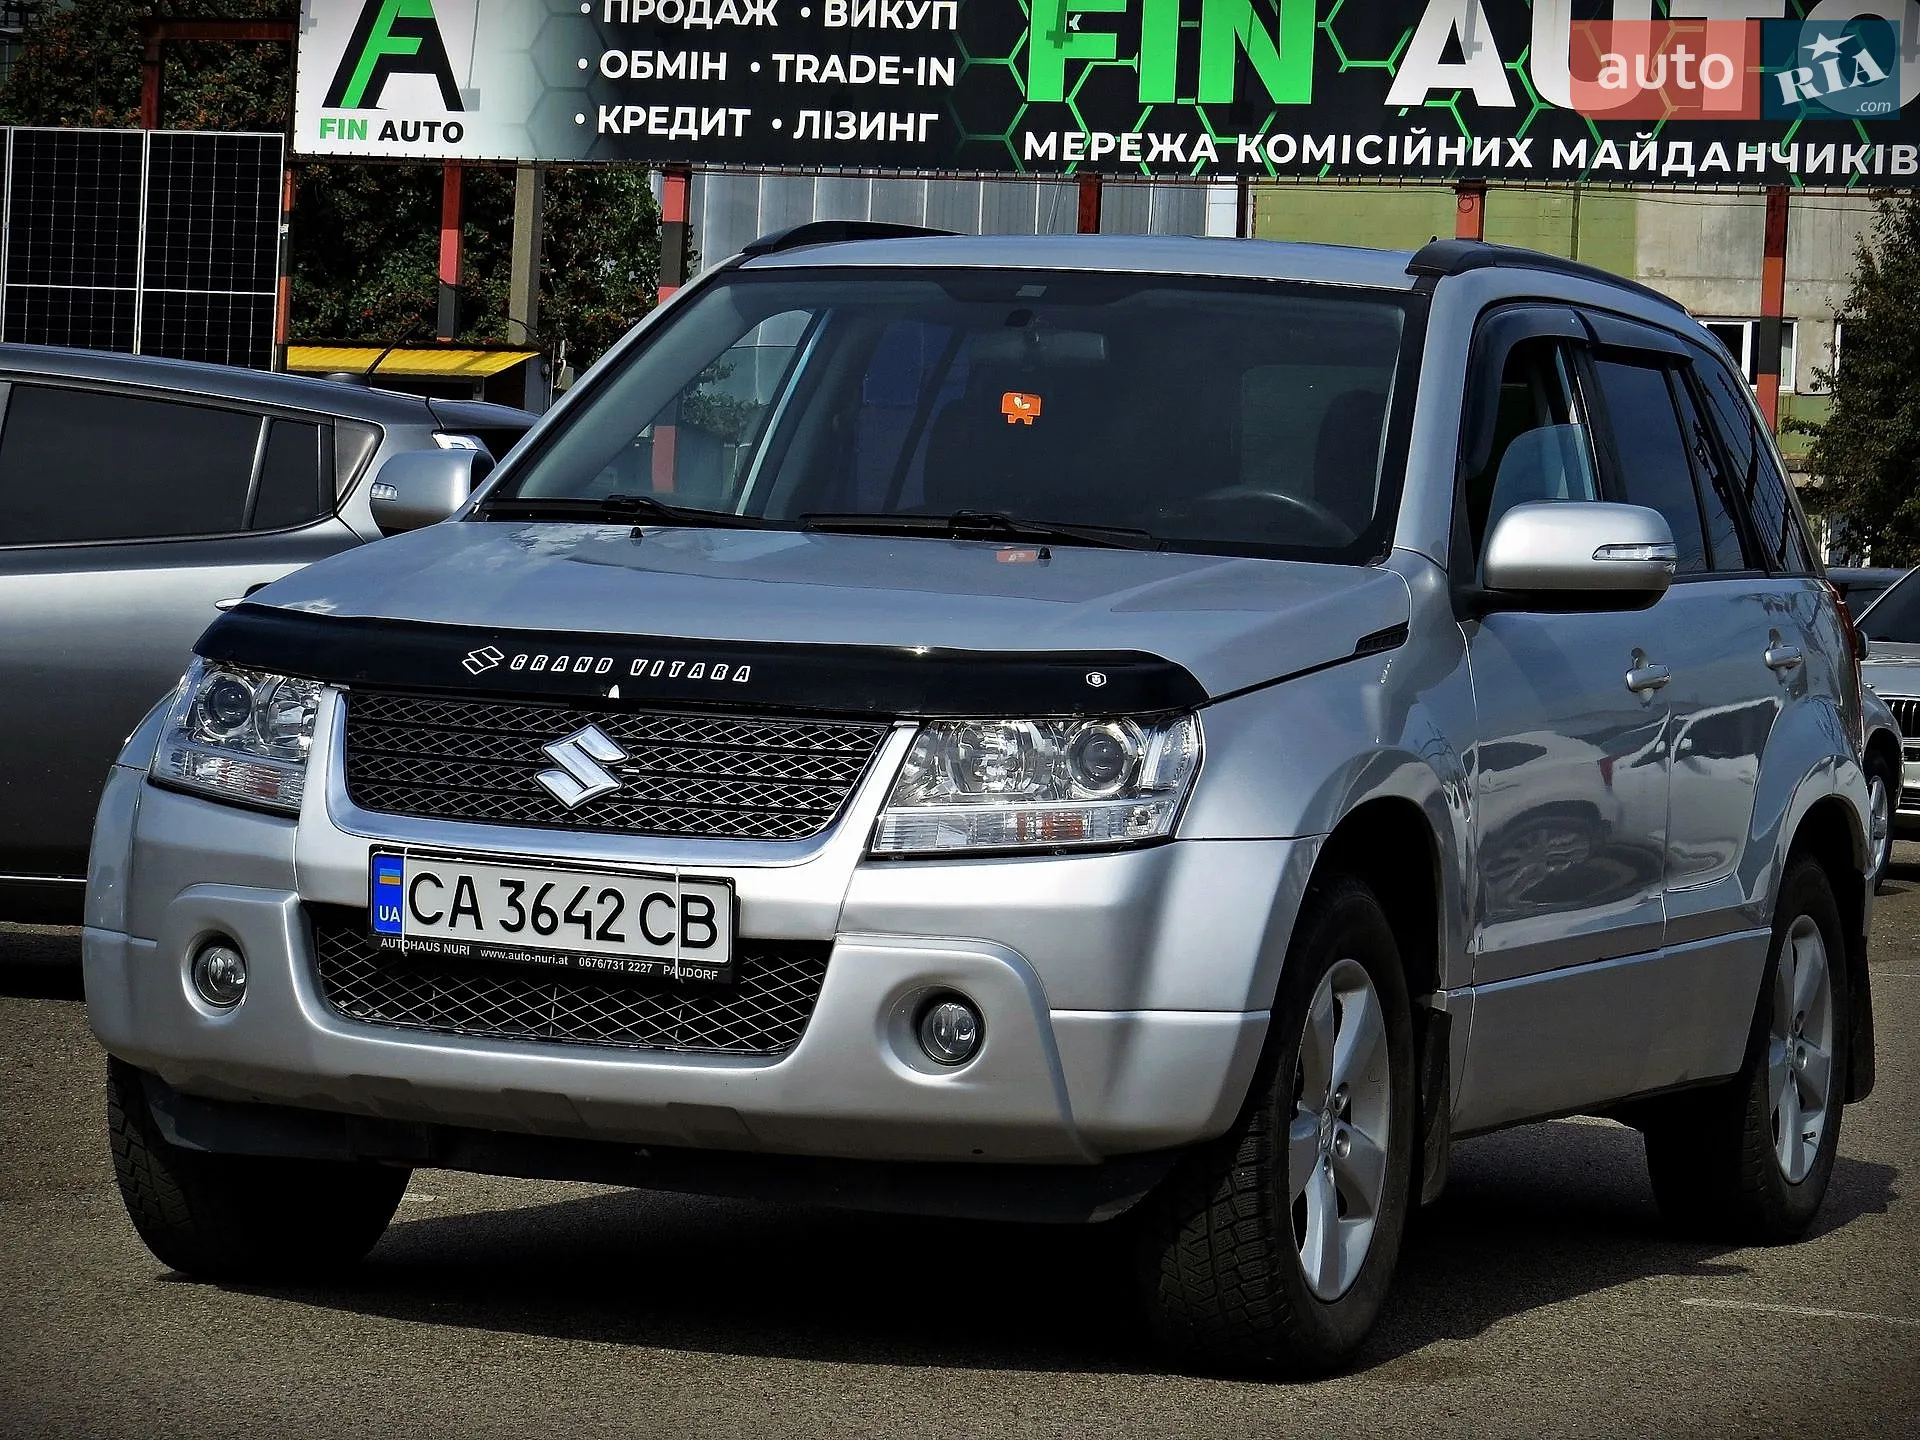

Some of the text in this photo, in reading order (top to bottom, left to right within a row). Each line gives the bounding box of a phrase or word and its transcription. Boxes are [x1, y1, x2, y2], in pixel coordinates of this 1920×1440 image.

[603, 0, 778, 30] ПРОДАЖ
[824, 0, 957, 31] ВИКУП
[600, 50, 727, 81] ОБМІН
[1026, 0, 1317, 104] FIN
[772, 53, 956, 87] TRADE-IN
[319, 118, 464, 144] FIN AUTO
[597, 105, 752, 140] КРЕДИТ
[793, 110, 939, 142] ЛІЗИНГ
[1024, 127, 1919, 177] МЕРЕЖА КОМІСІЙНИХ МАЙДАНЧИКІВ
[510, 654, 751, 682] GRAND VITARA
[378, 905, 401, 923] UA
[408, 872, 719, 949] CA 3642 CB
[380, 938, 719, 981] AUTOHAUS NURI www.auto-nuri.at 0676/731 2227 PAUDORF
